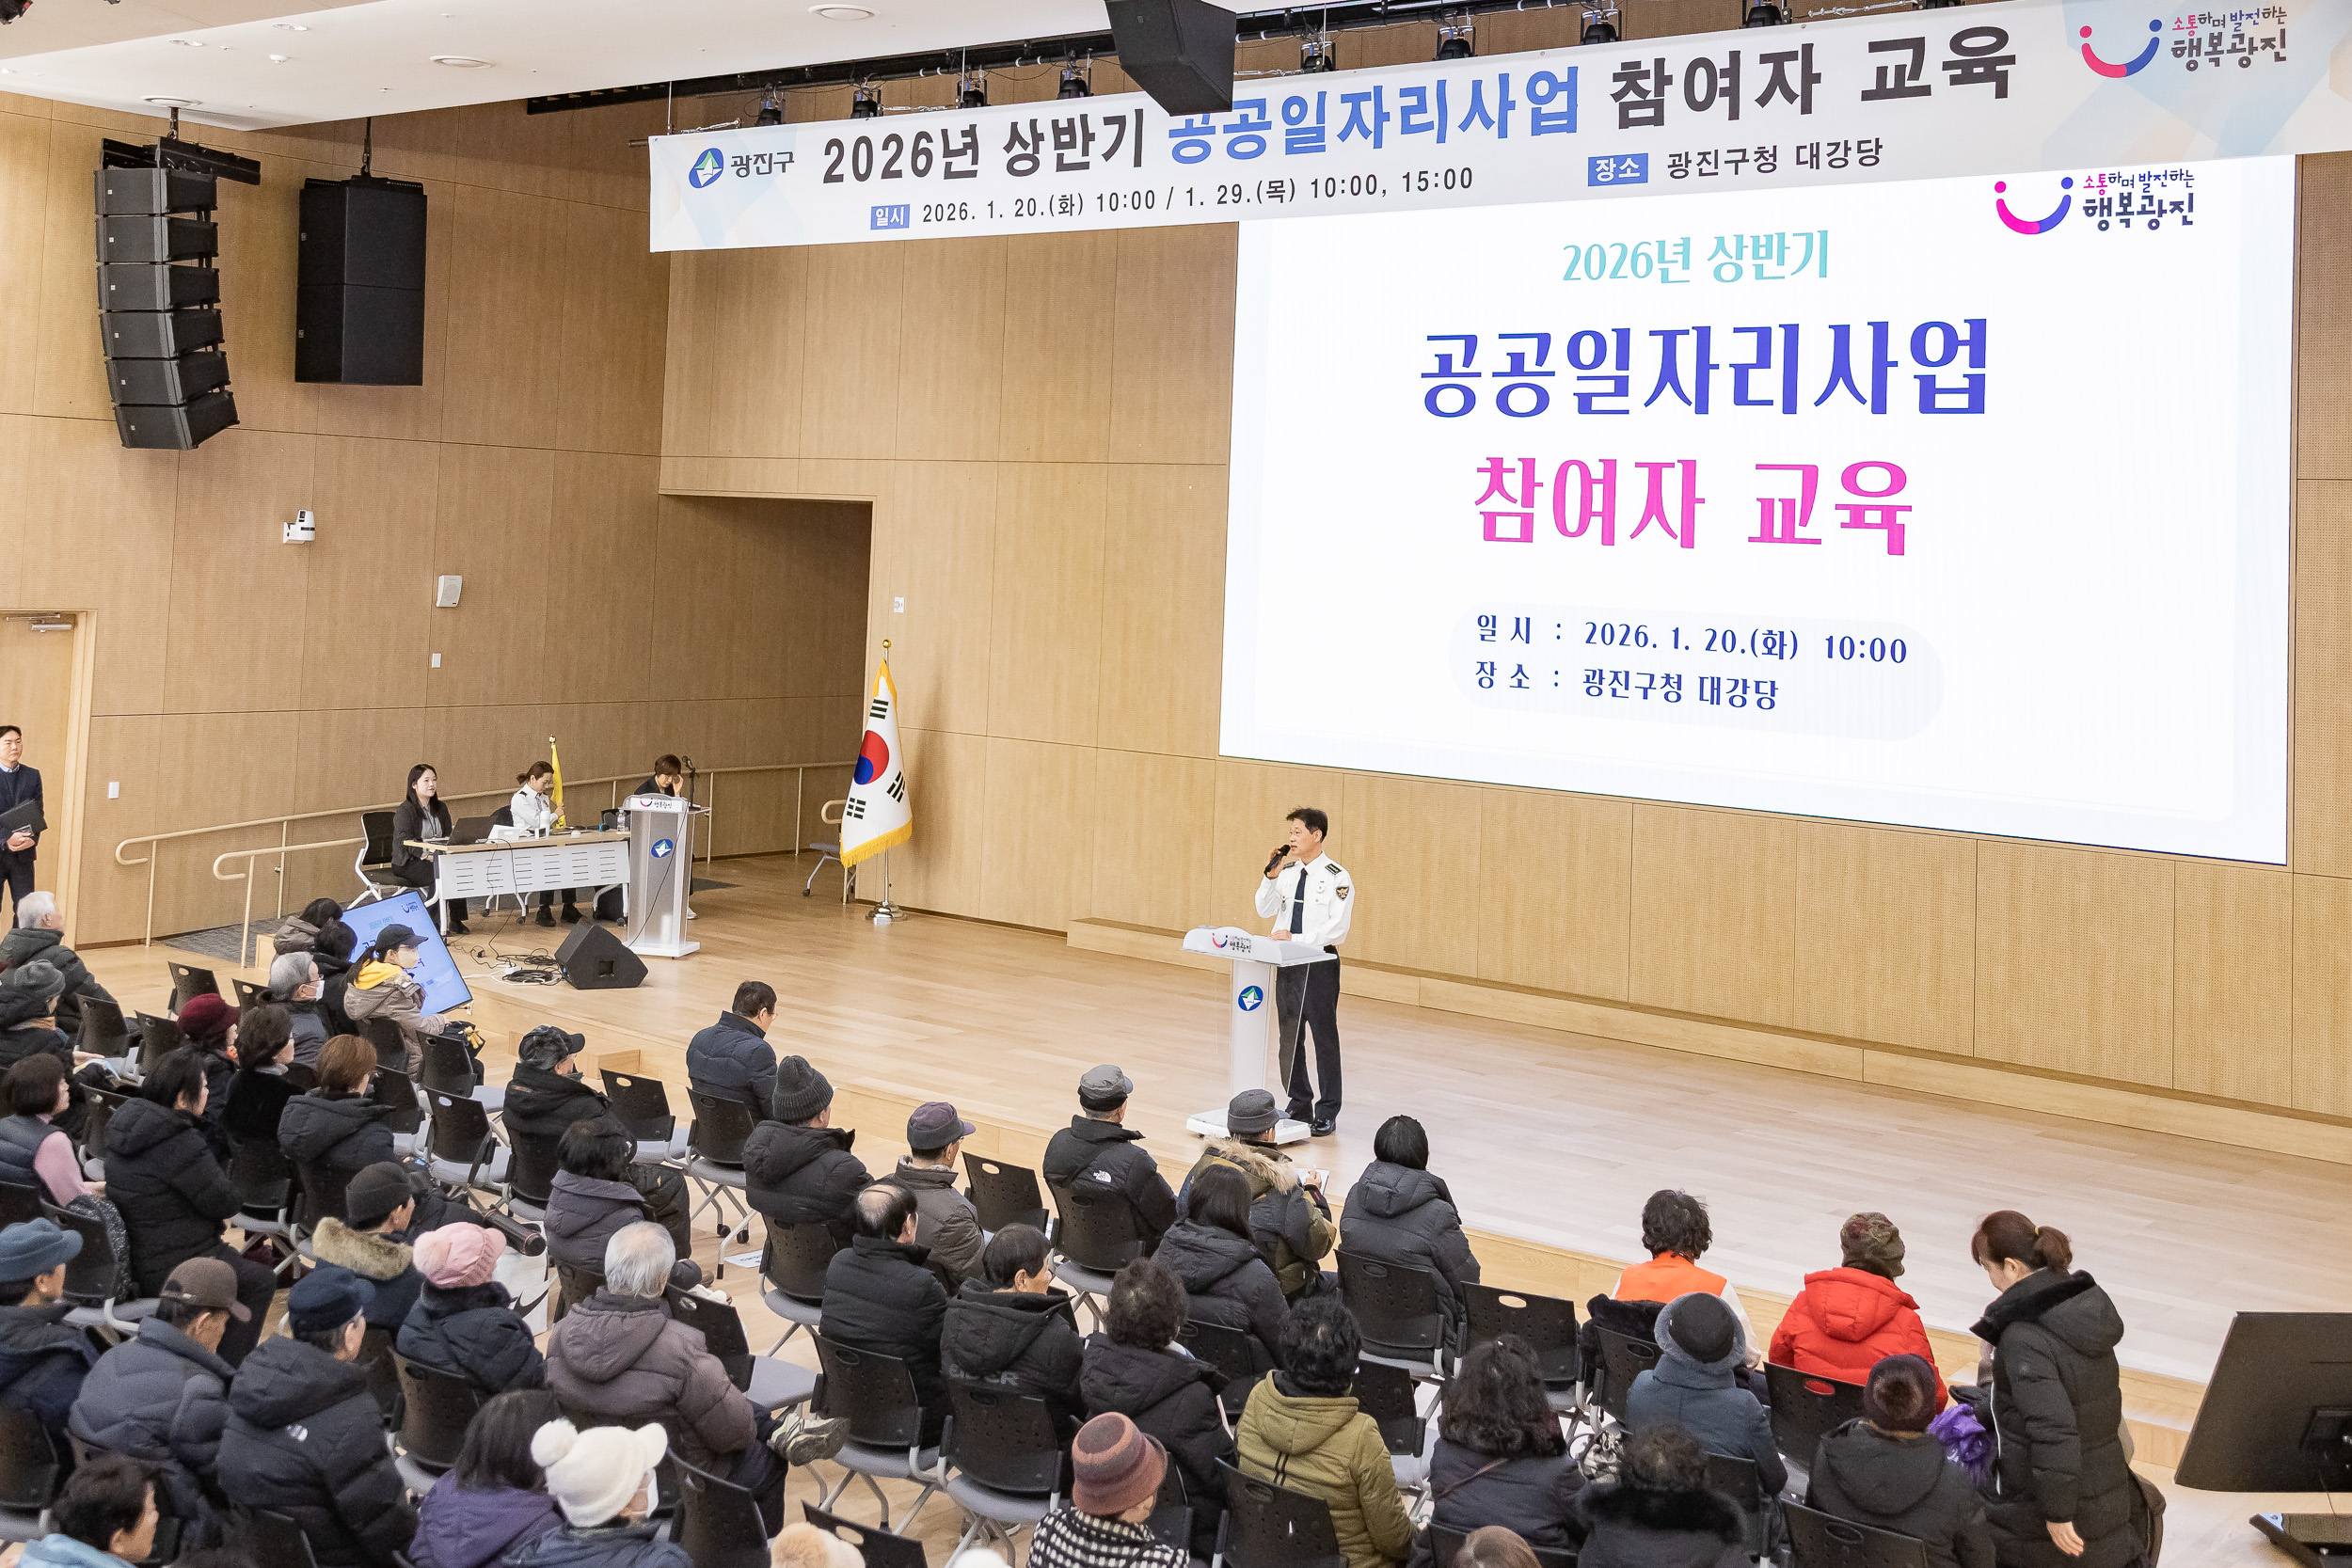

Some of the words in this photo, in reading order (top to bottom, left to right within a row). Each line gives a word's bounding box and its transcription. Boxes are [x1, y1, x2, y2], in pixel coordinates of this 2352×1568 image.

[2230, 6, 2287, 32] 발전하는
[2170, 28, 2287, 71] 행복광진
[822, 123, 978, 183] 2026년
[1003, 108, 1144, 177] 상반기
[1168, 66, 1579, 164] 공공일자리사업
[1610, 42, 1822, 130] 참여자
[1860, 25, 2016, 103] 교육
[731, 151, 795, 178] 광진구
[1595, 157, 1642, 182] 장소
[1667, 145, 1779, 179] 광진구청
[1796, 138, 1883, 170] 대강당
[2138, 168, 2195, 193] 발전하는
[874, 206, 905, 228] 일시
[922, 203, 976, 223] 2026.
[987, 200, 1004, 219] 1.
[1014, 192, 1084, 217] 20.(화)
[1096, 190, 1156, 213] 10:00
[1184, 187, 1205, 206] 1.
[1216, 178, 1296, 205] 29.(목)
[1311, 174, 1388, 198] 10:00,
[1402, 166, 1473, 193] 15:00
[2083, 192, 2193, 231] 행복광진
[1562, 237, 1691, 284] 2026년
[1707, 230, 1828, 282] 상반기
[1421, 318, 1987, 418] 공공일자리사업
[1474, 457, 1706, 549] 참여자
[1748, 461, 1913, 556] 교육
[1584, 622, 1658, 649] 2026.
[1671, 626, 1690, 651] 1.
[1704, 627, 1798, 660] 20.(화)
[1825, 635, 1907, 664] 10:00
[1582, 668, 1683, 704] 광진구청
[1698, 675, 1779, 710] 대강당
